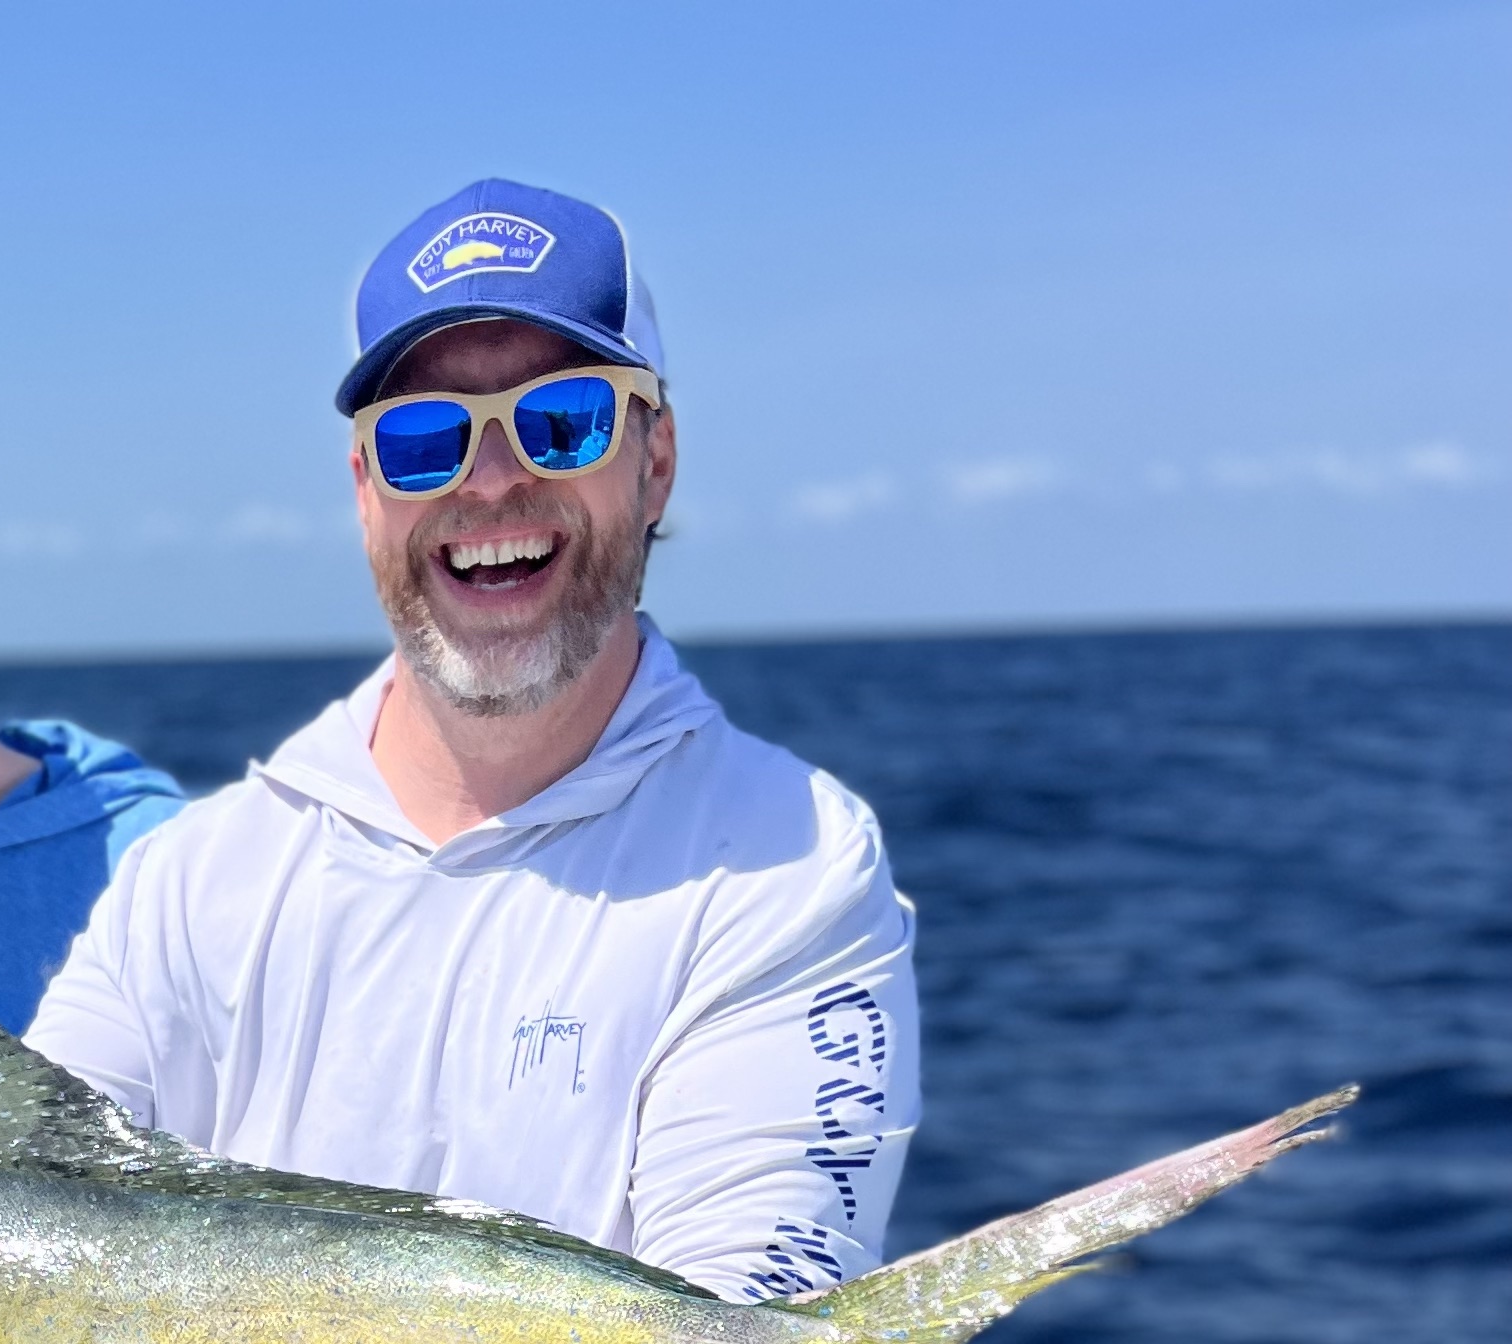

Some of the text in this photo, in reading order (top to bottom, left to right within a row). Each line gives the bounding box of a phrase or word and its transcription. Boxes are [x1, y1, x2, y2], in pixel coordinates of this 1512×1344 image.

[419, 219, 543, 267] GUY HARVEY
[805, 981, 885, 1230] GUY
